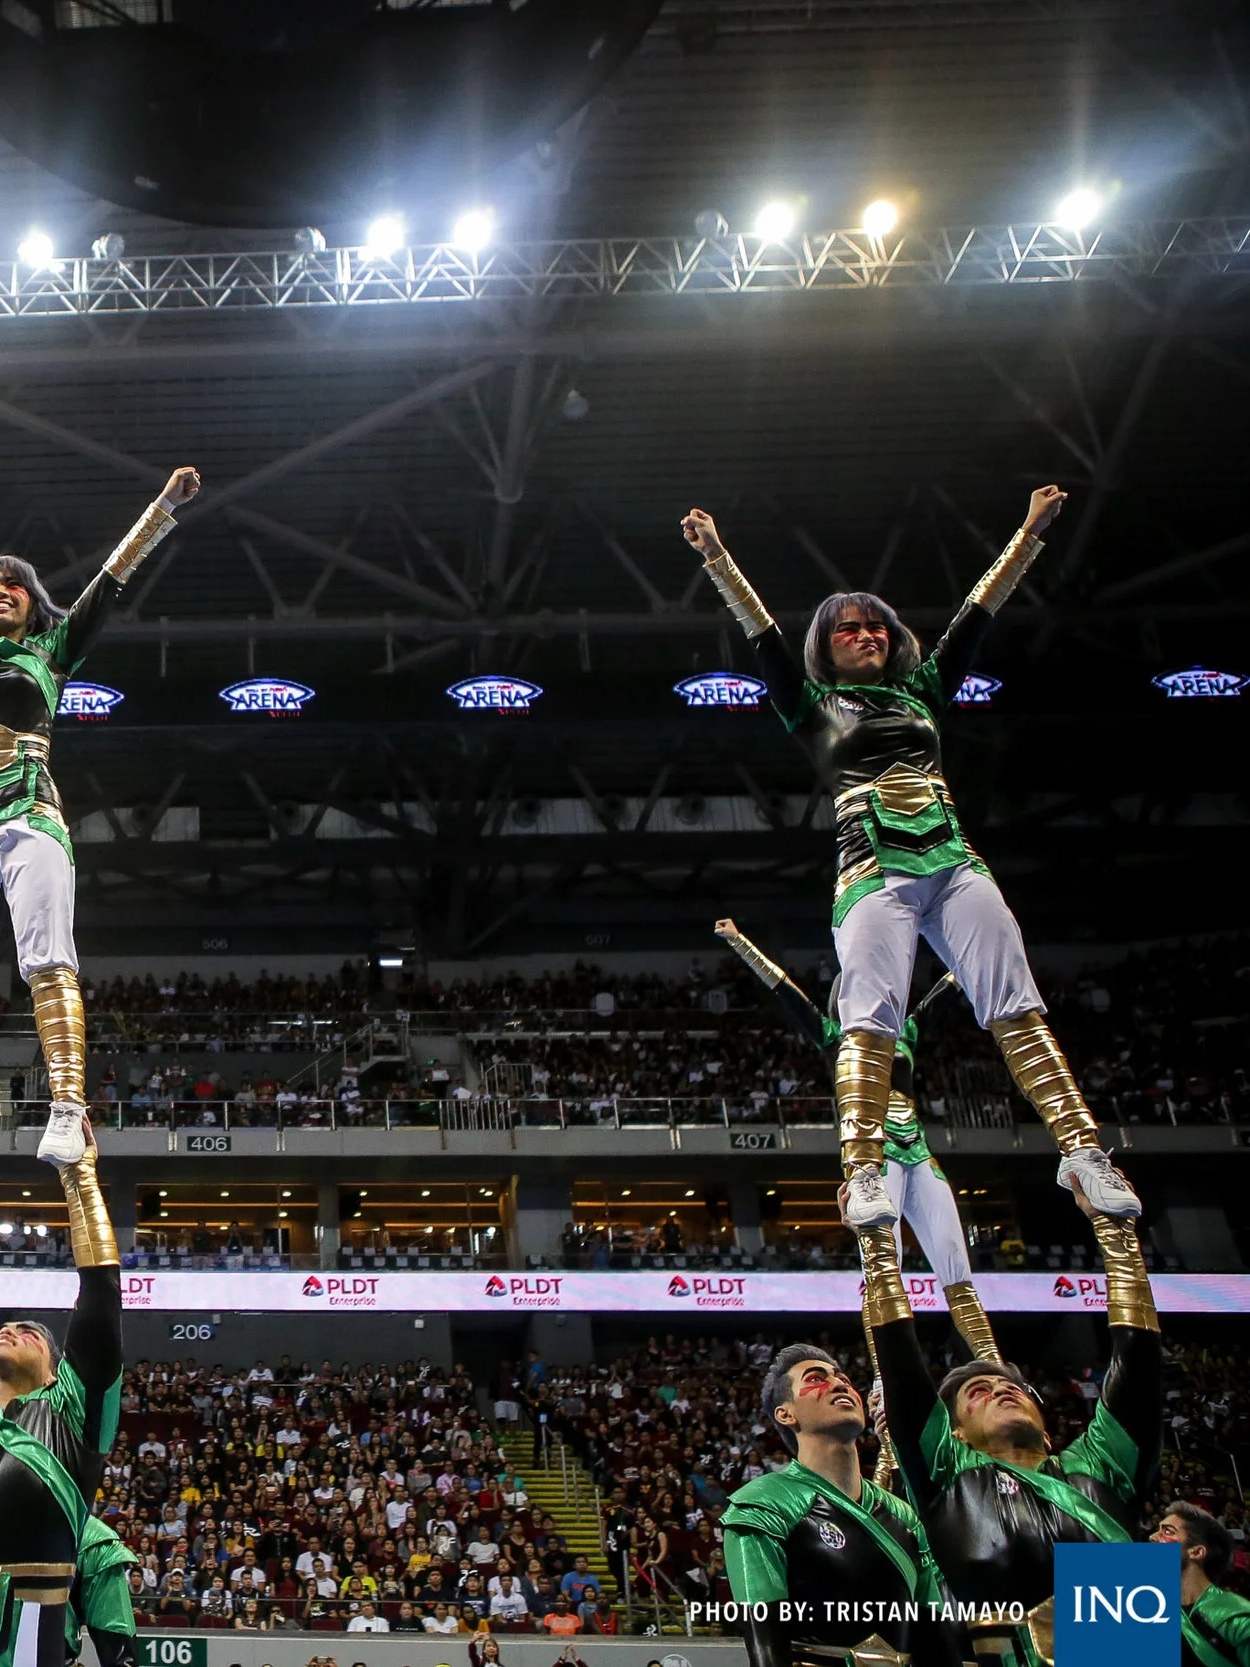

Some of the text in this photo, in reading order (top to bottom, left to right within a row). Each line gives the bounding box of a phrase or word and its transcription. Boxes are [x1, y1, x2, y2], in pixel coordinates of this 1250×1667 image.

[692, 686, 755, 703] ARENA
[1172, 679, 1237, 696] ARENA
[58, 697, 106, 712] RENA
[235, 692, 299, 708] ARENA
[463, 690, 527, 706] ARENA
[191, 1137, 227, 1150] 406
[735, 1134, 771, 1148] 407
[120, 1278, 155, 1294] LDT
[327, 1278, 379, 1295] PLDT
[510, 1278, 563, 1295] PLDT
[693, 1278, 746, 1295] PLDT
[908, 1278, 938, 1295] LDT
[1078, 1279, 1107, 1295] PL
[330, 1297, 376, 1306] Enterprise
[514, 1297, 560, 1306] Enterprise
[697, 1297, 744, 1307] Enterprise
[173, 1324, 211, 1340] 206
[145, 1640, 192, 1664] 106
